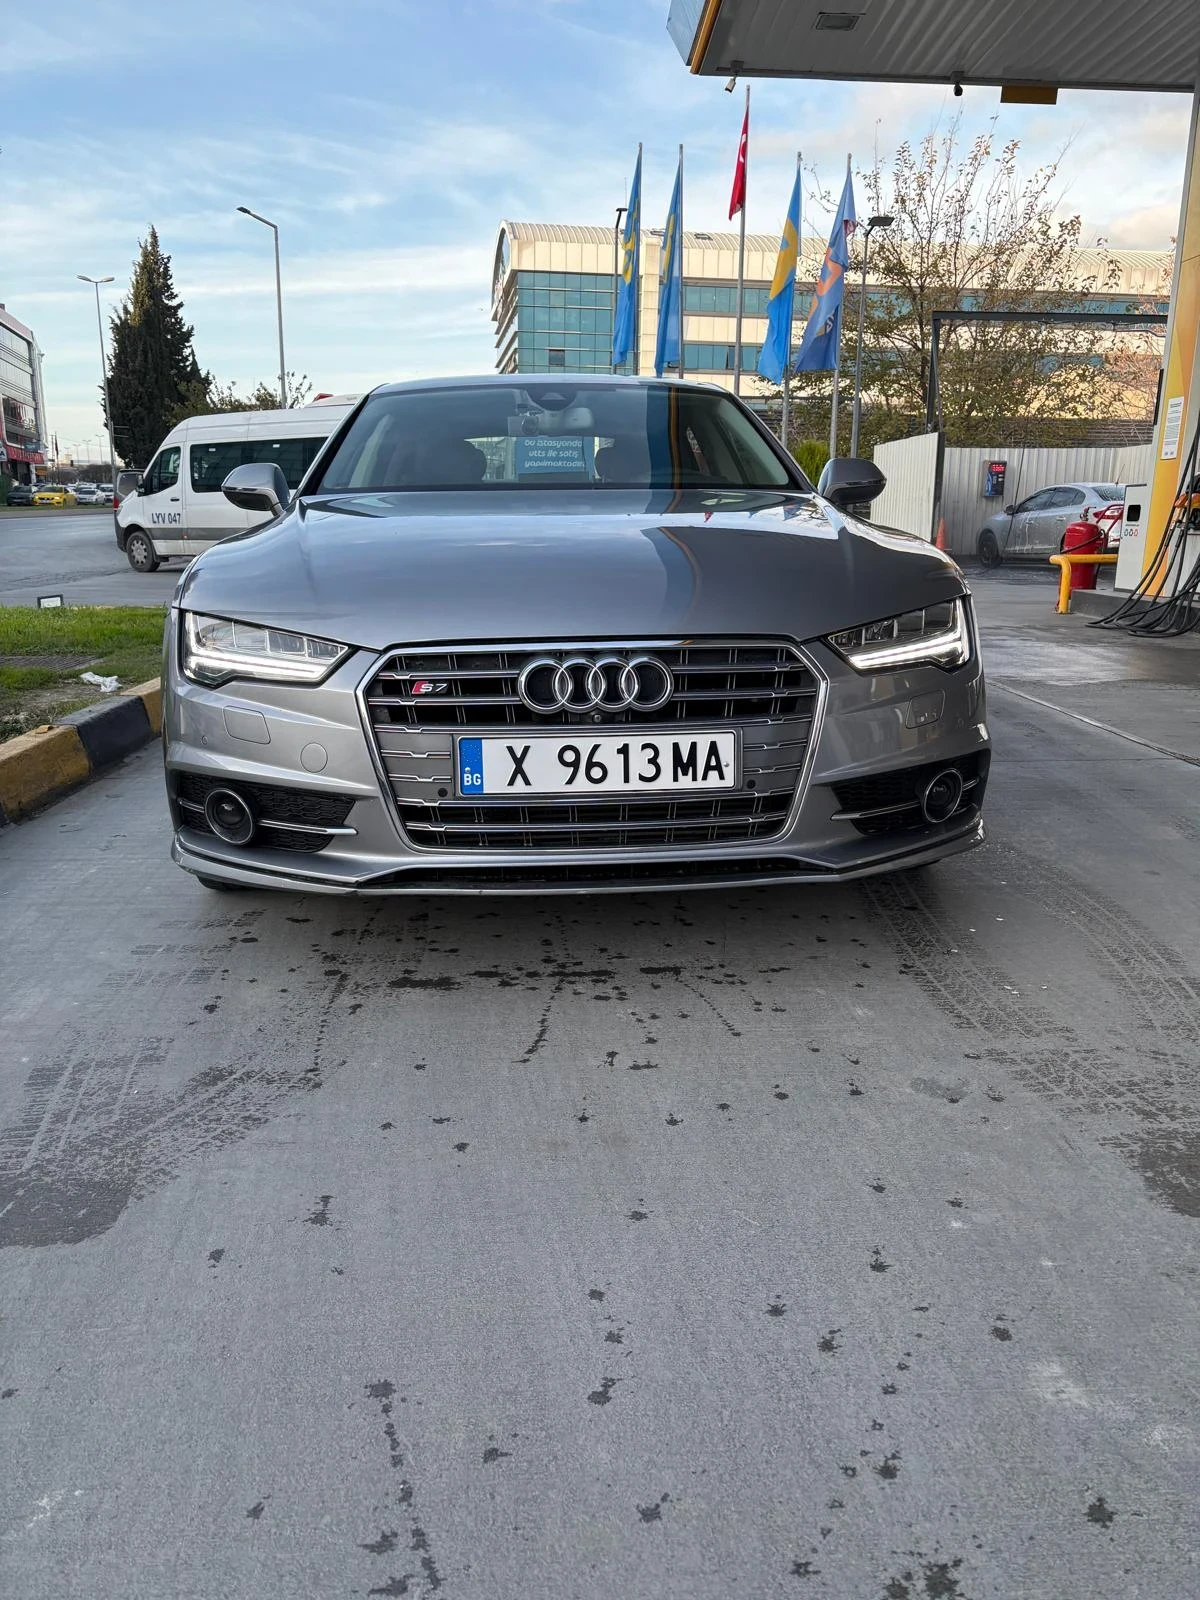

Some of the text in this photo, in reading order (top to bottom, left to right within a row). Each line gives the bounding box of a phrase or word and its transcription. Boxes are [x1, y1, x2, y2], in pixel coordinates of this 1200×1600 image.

[151, 512, 181, 525] LYV 047
[419, 683, 448, 693] S7
[506, 739, 726, 787] X 9613 MA
[463, 773, 482, 786] BG
